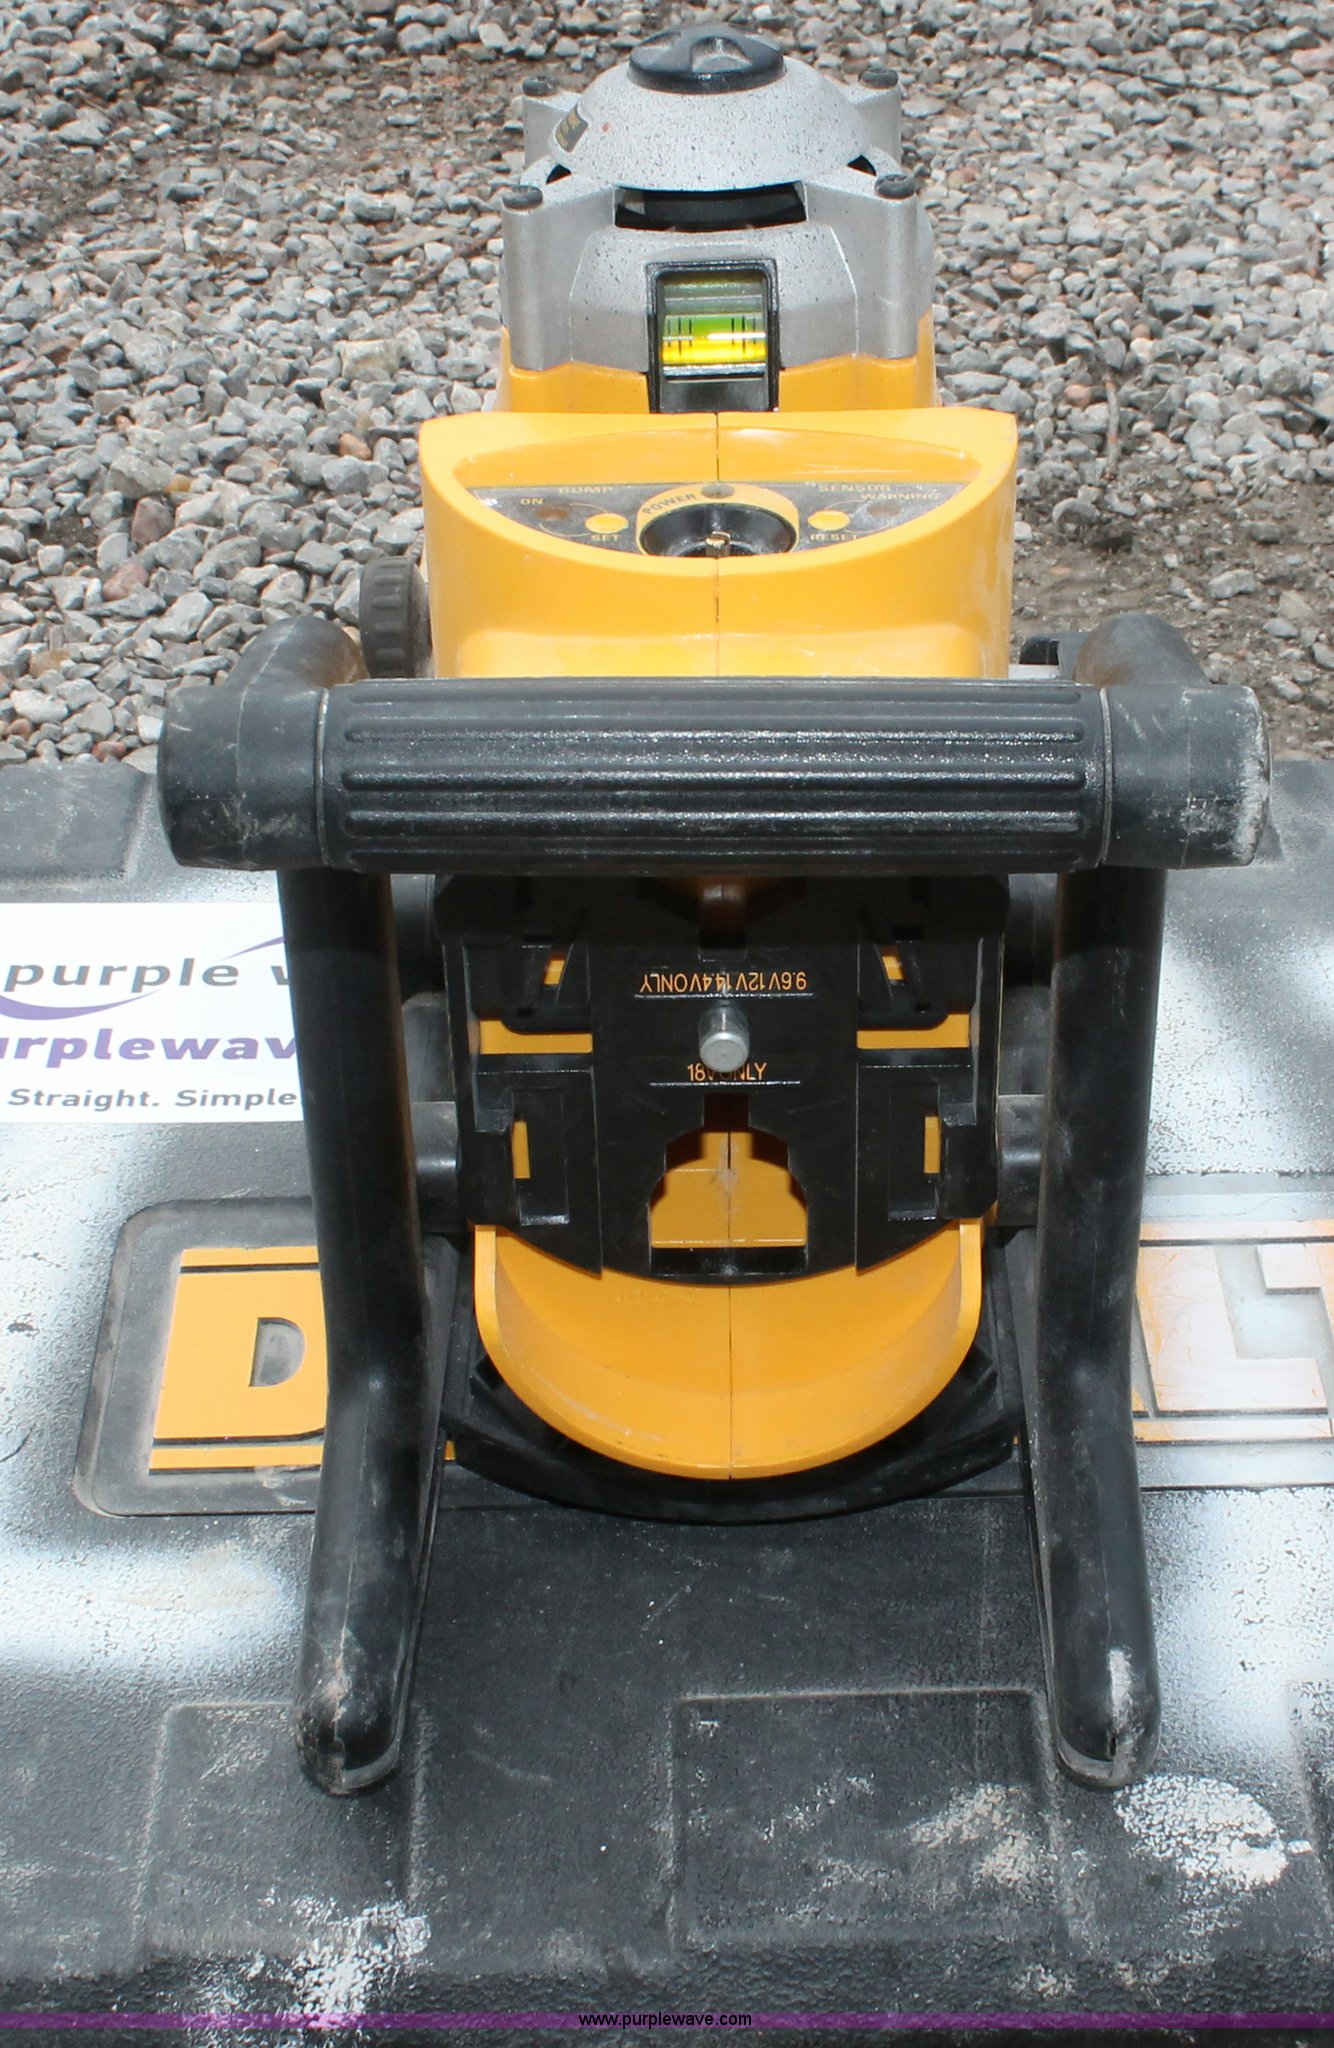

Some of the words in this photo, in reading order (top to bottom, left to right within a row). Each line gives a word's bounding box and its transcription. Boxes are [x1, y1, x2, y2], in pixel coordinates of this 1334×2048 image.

[818, 484, 891, 492] SENSOR
[859, 492, 942, 500] WARNING
[642, 493, 697, 515] POWER
[591, 534, 621, 542] SET
[810, 533, 859, 542] RESET
[3, 958, 240, 993] purple
[640, 973, 688, 993] ONLY
[689, 972, 732, 992] 14.4V
[735, 972, 764, 991] 12V
[769, 971, 807, 990] 9.6V
[7, 1088, 160, 1111] Straight.
[174, 1088, 298, 1110] Simple
